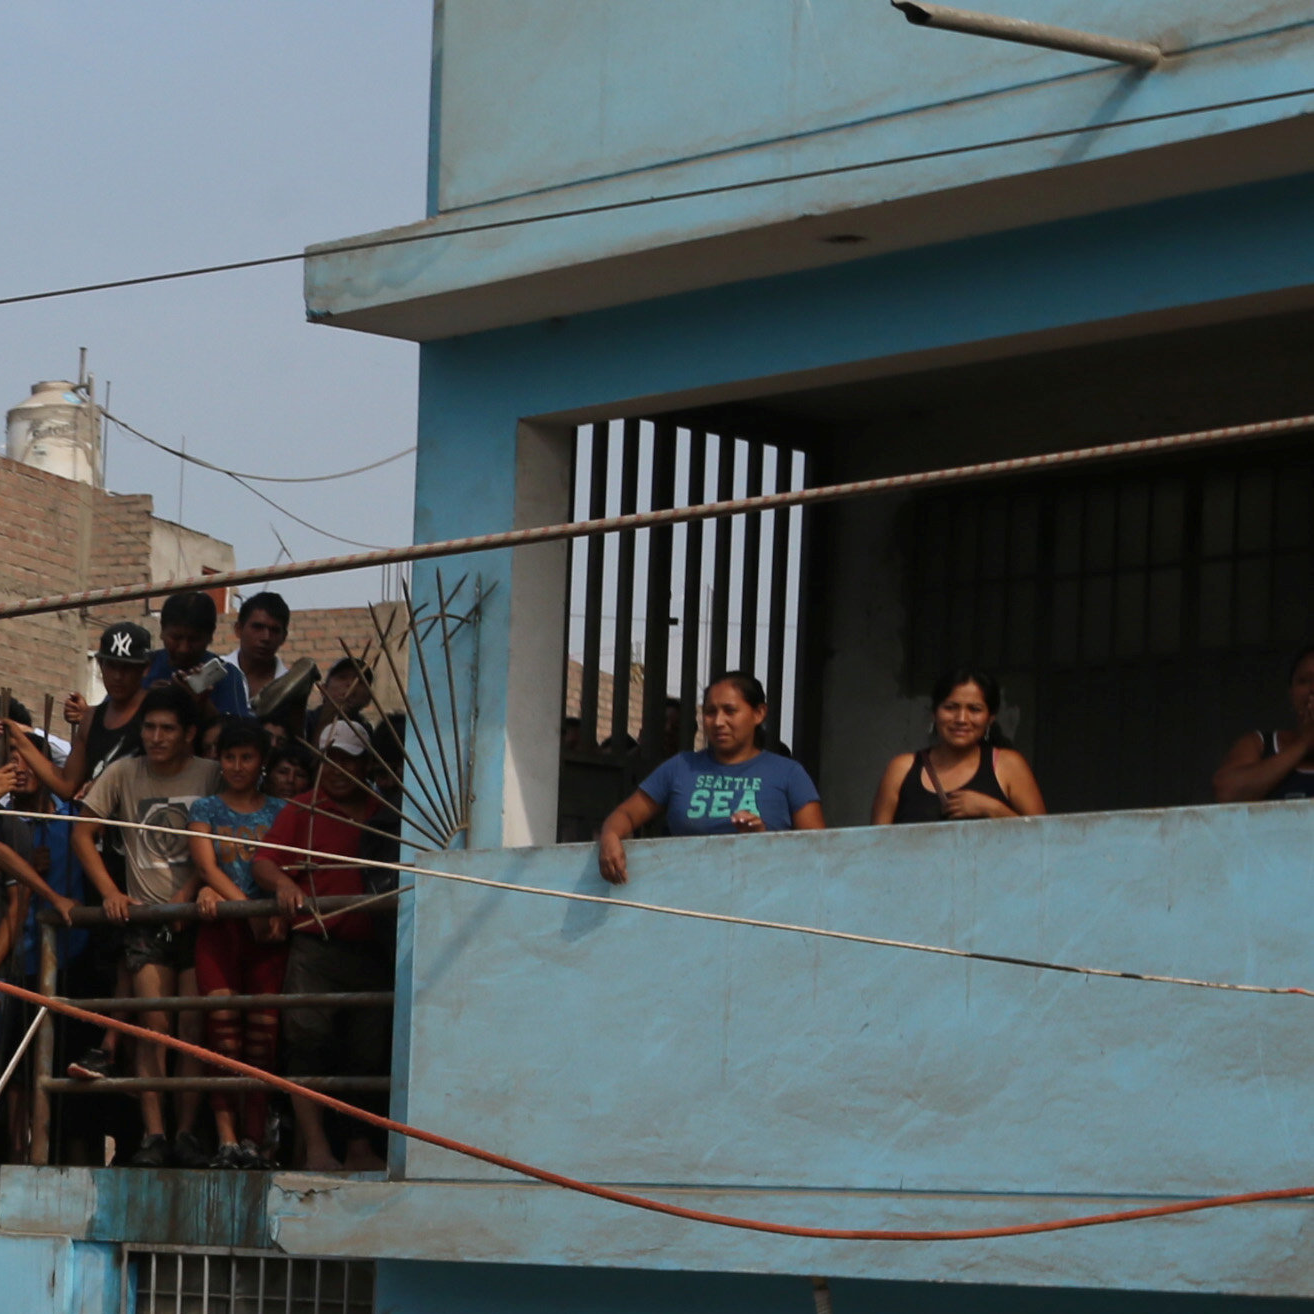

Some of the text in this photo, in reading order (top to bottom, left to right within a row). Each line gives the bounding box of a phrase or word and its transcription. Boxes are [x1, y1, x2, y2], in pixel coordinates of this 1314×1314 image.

[110, 631, 133, 657] NY
[695, 774, 761, 791] SEATTLE
[687, 789, 761, 818] SEA
